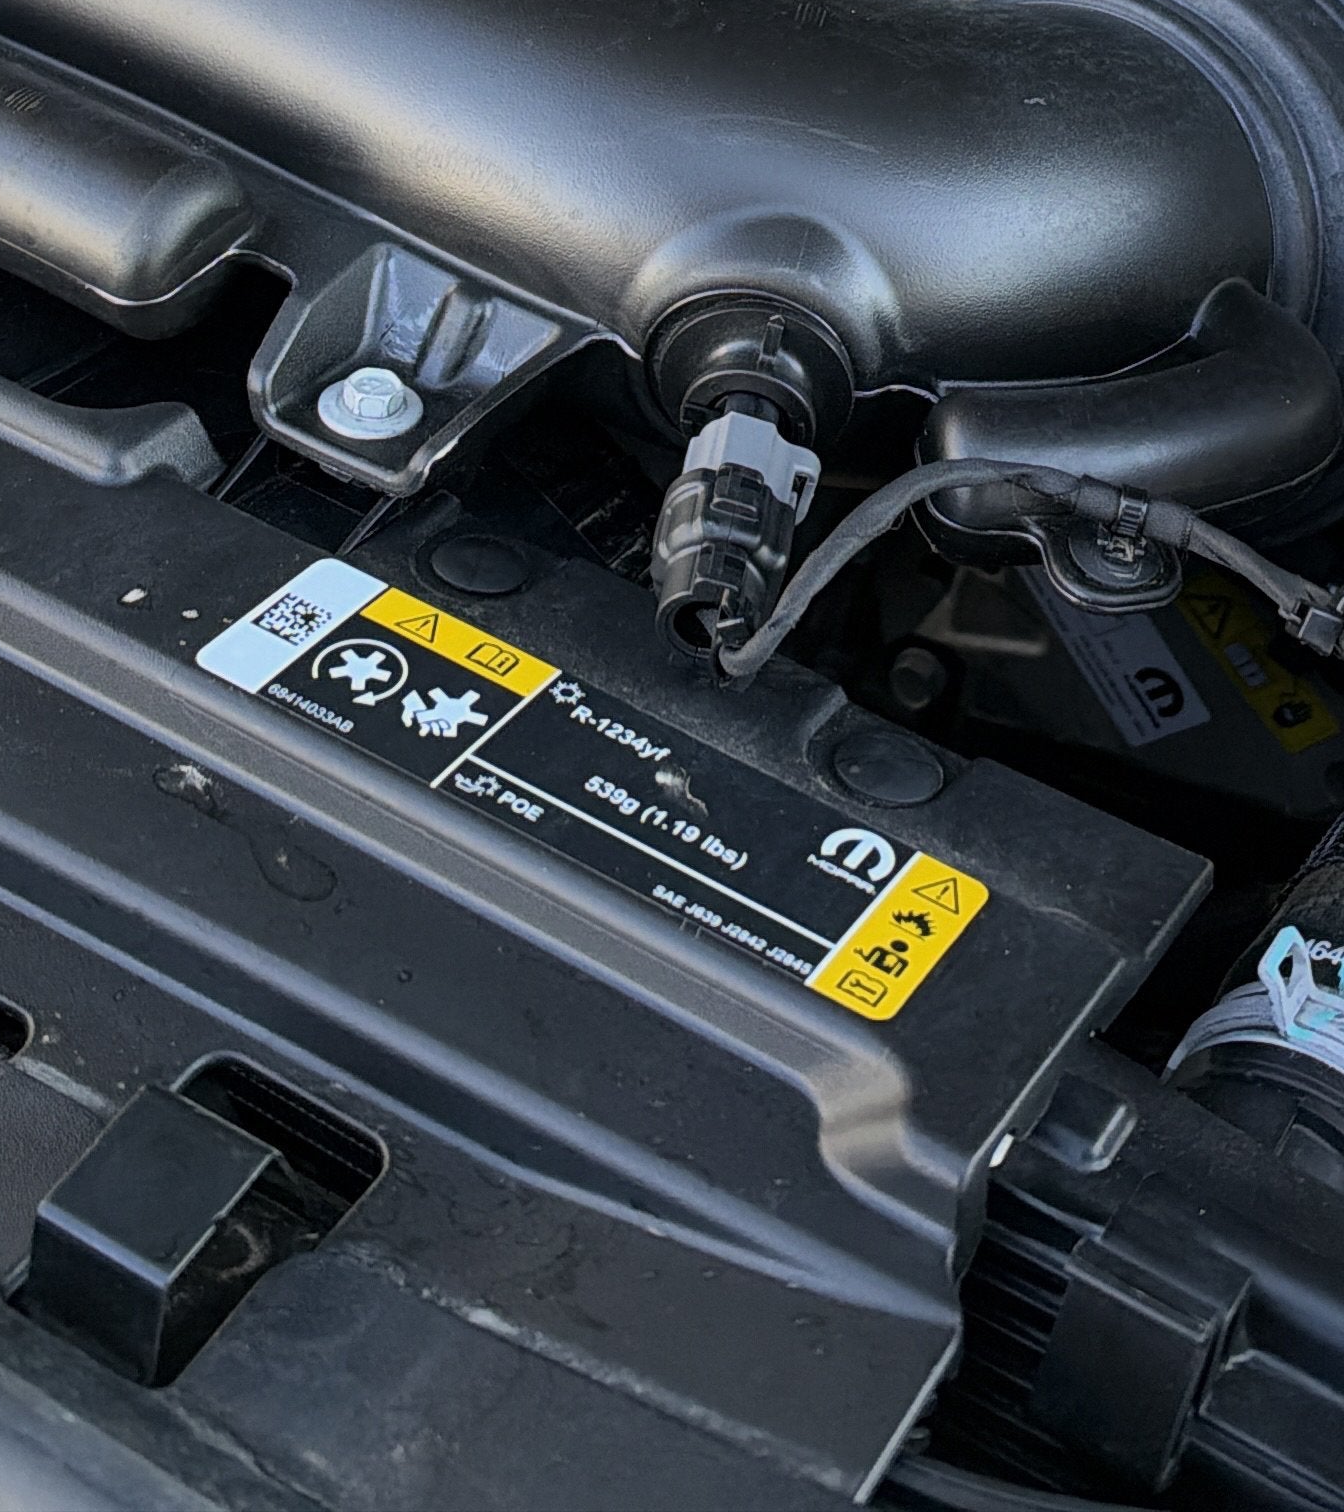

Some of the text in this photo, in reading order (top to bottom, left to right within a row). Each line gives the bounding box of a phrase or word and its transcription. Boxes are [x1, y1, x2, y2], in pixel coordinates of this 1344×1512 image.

[569, 704, 672, 762] R-1234yf
[496, 790, 545, 823] POE
[584, 775, 749, 871] 539g (1.19 lbs)
[652, 884, 688, 909] SAE
[684, 903, 723, 928] J639
